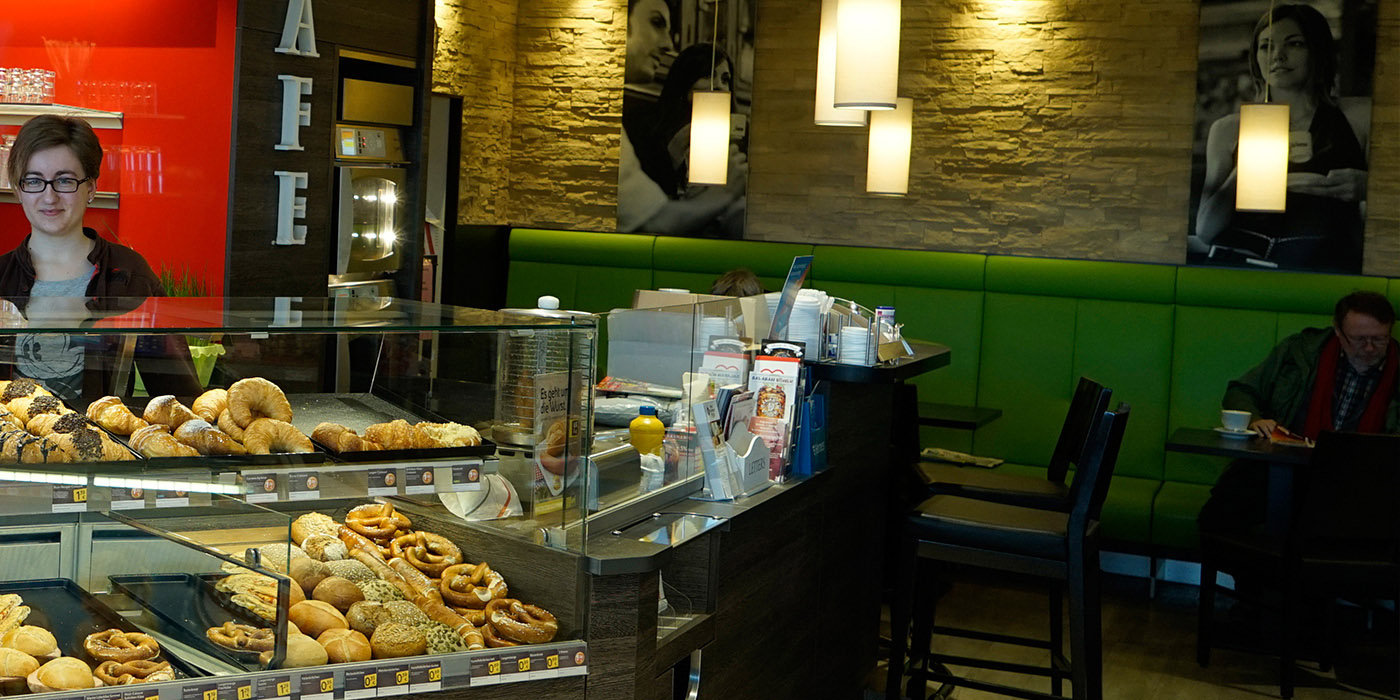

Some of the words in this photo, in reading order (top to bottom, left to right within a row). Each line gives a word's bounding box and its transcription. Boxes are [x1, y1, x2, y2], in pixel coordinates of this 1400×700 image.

[541, 388, 548, 400] Es
[548, 387, 560, 402] geht
[540, 403, 549, 414] die
